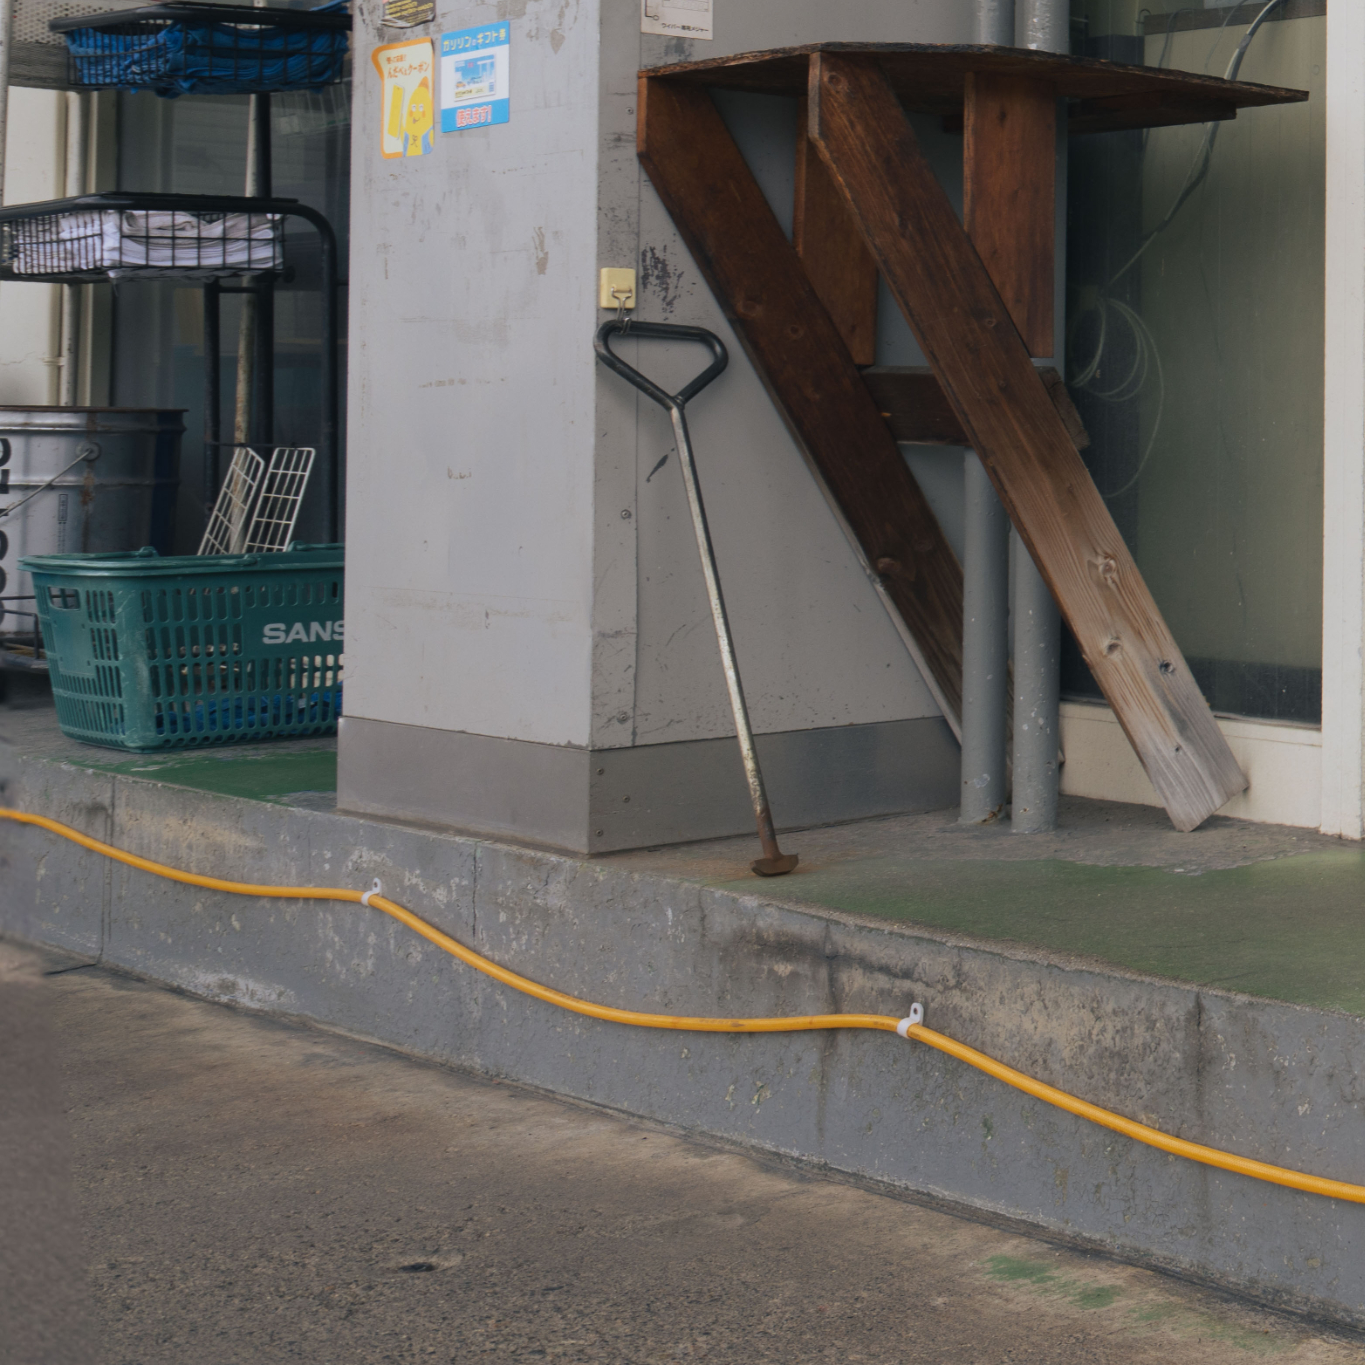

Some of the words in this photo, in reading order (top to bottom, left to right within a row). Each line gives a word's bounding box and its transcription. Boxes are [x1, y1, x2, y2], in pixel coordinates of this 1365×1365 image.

[443, 27, 507, 53] ガソリンのギフト券
